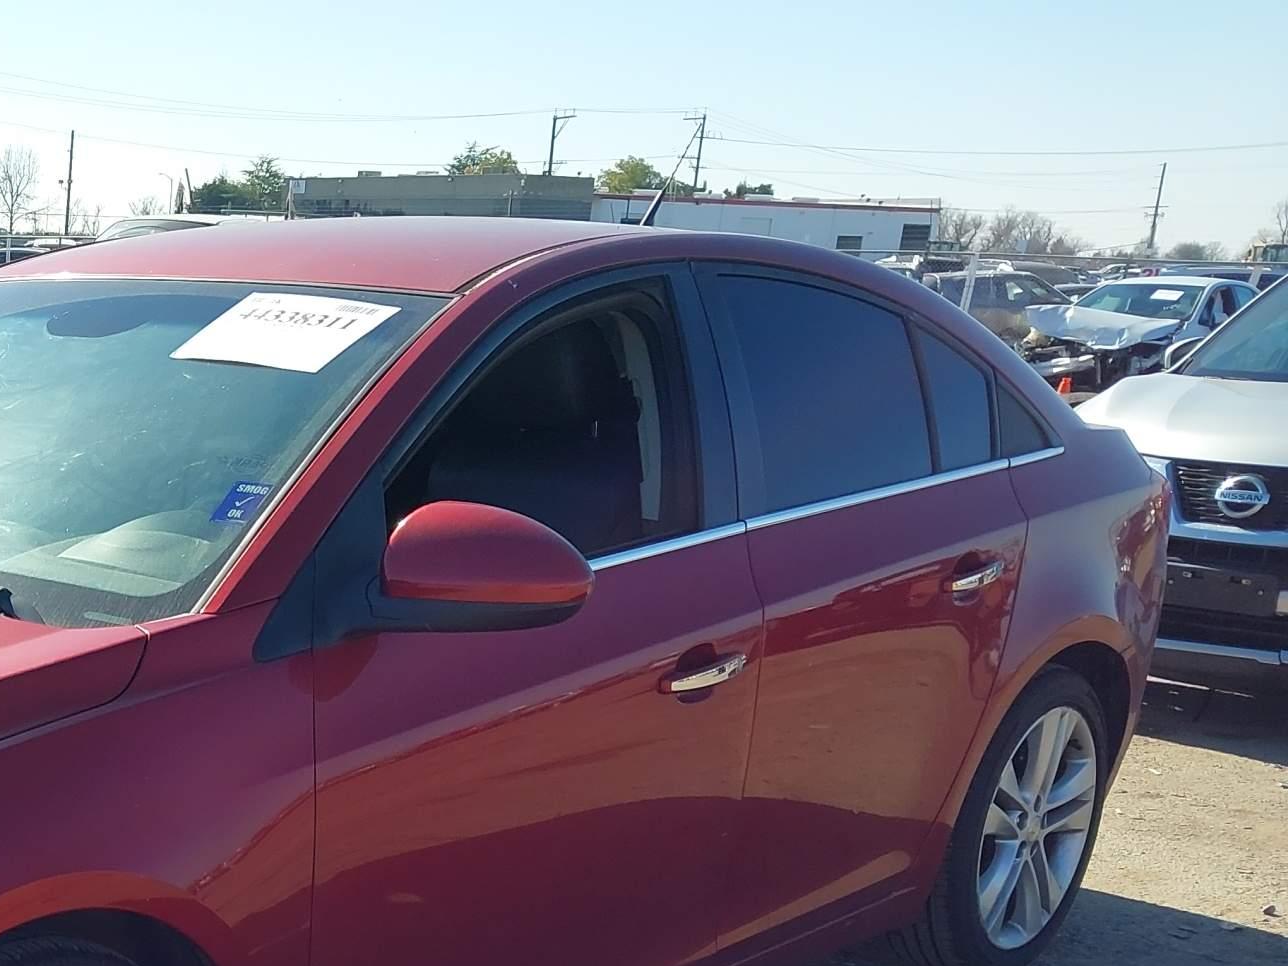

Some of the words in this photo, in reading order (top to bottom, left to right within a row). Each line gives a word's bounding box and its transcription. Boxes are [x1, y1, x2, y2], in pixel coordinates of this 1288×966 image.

[240, 308, 359, 330] 44338311
[236, 484, 269, 495] SMOG
[1220, 491, 1263, 502] NISSAN
[227, 509, 244, 519] OK
